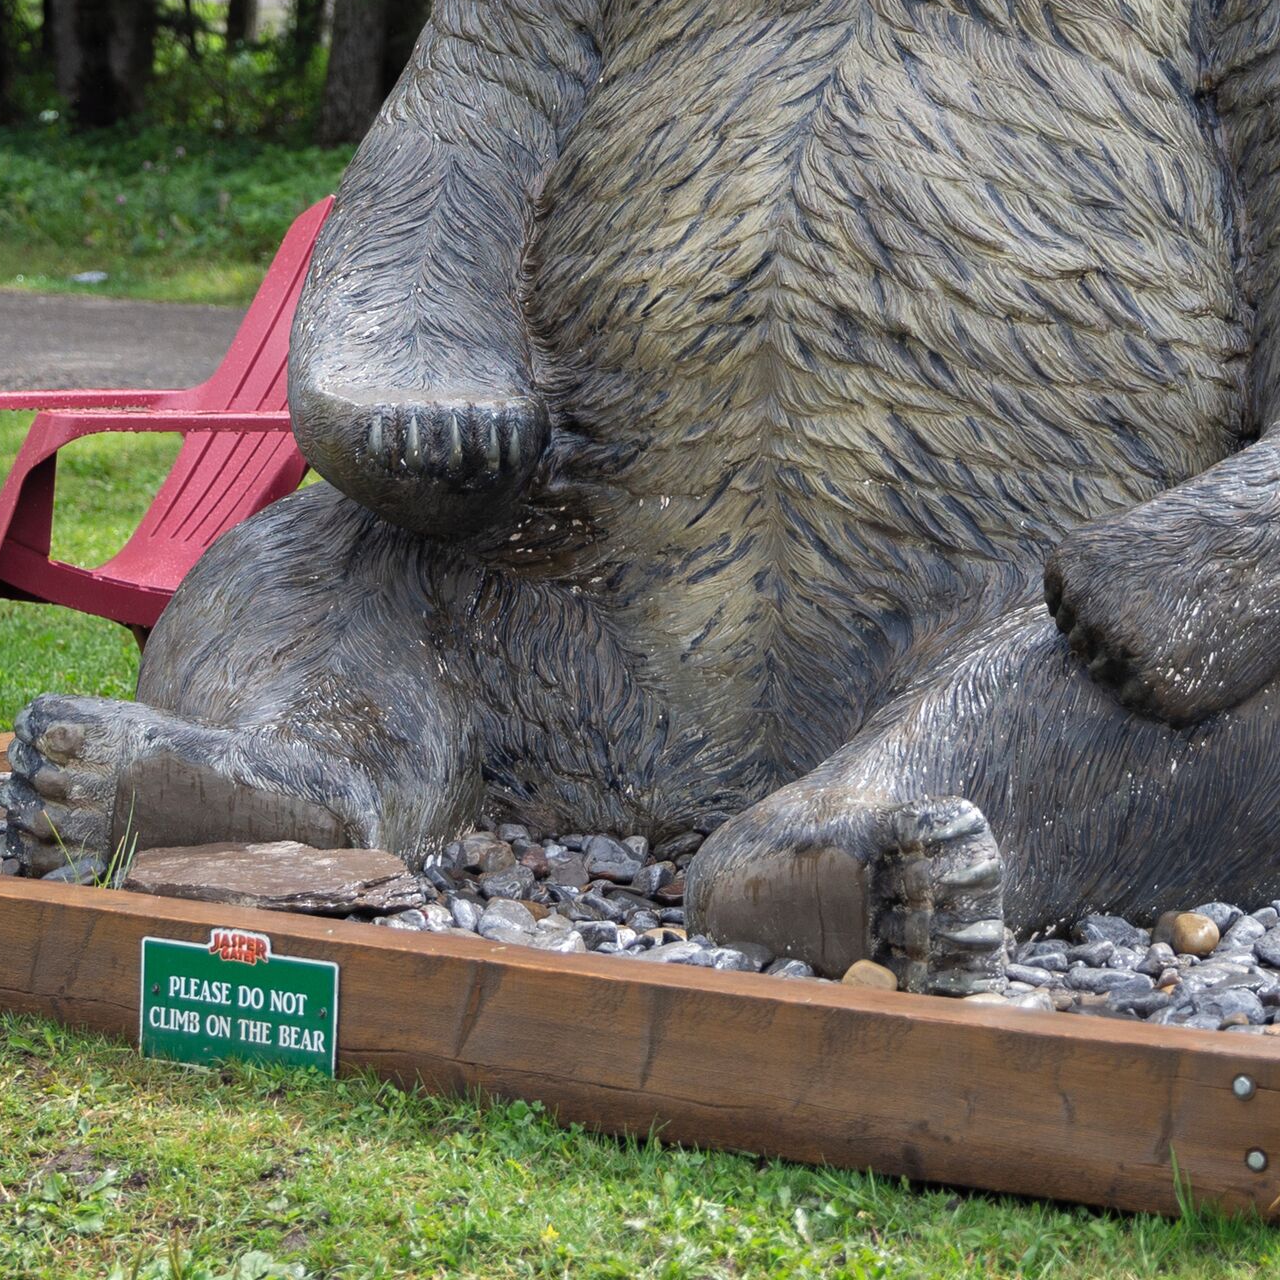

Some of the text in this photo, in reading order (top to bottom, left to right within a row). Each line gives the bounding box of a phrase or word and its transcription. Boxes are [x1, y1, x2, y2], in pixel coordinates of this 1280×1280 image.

[208, 932, 269, 962] JASPER
[168, 975, 308, 1016] PLEASE DO NOT
[149, 1005, 326, 1053] CLIMB ON THE BEAR
